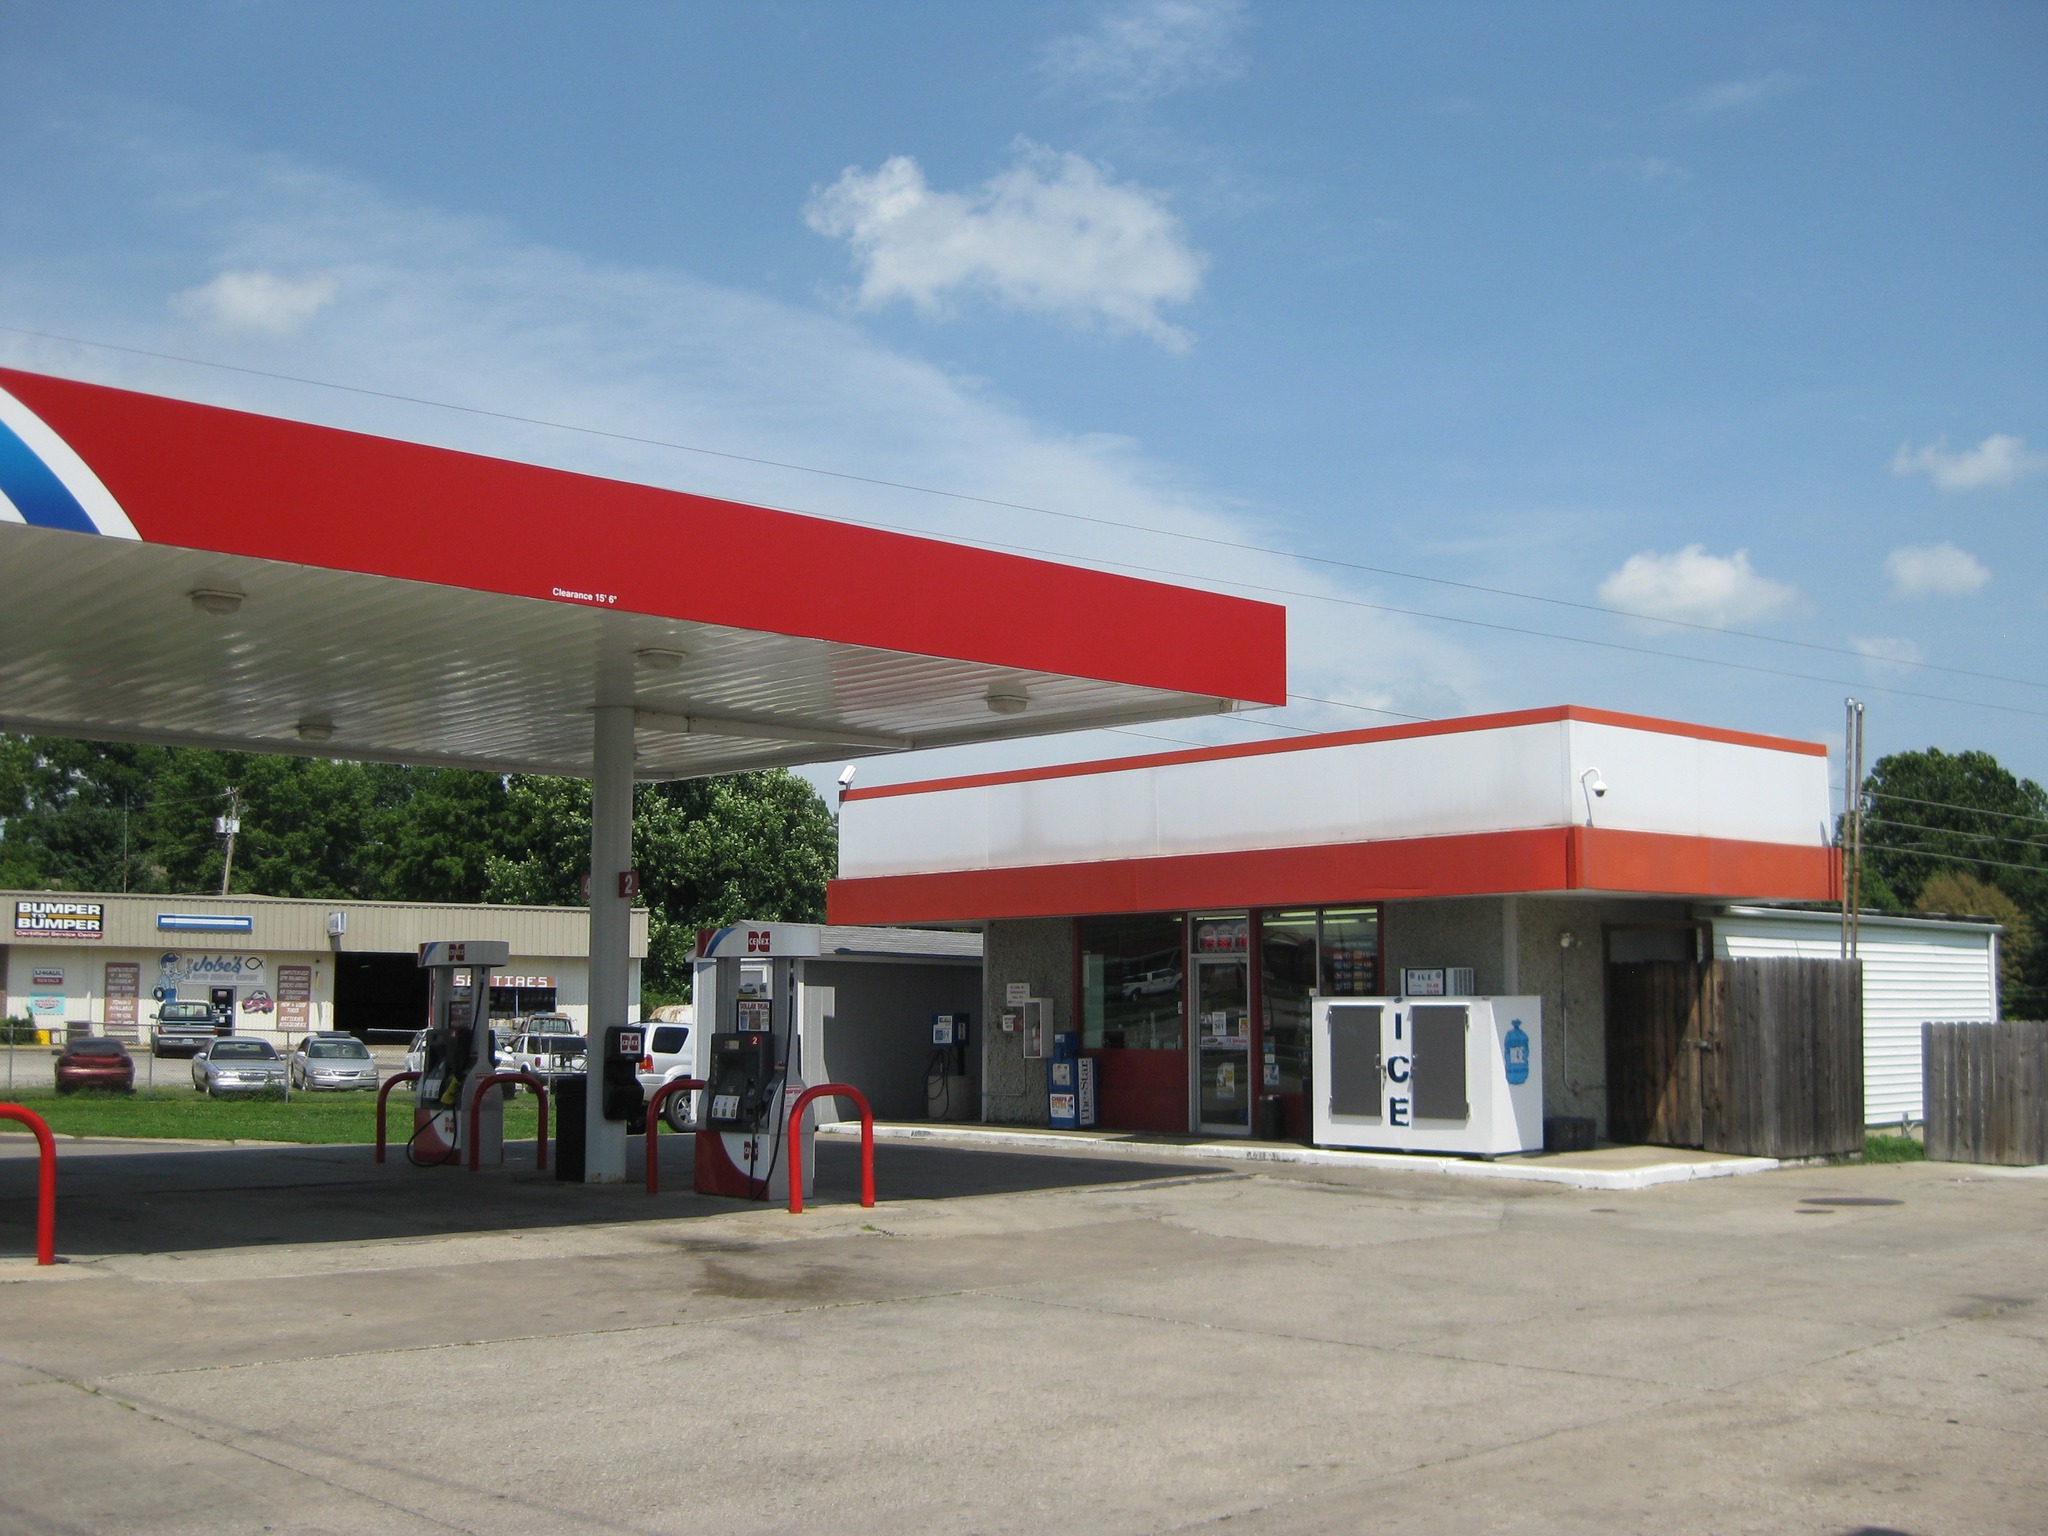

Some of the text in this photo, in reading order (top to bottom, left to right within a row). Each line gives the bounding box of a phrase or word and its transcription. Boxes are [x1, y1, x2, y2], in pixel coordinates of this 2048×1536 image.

[552, 587, 593, 601] Clearance
[595, 593, 607, 602] 15'
[625, 874, 633, 894] 2
[18, 902, 101, 915] BUMPER
[18, 917, 100, 931] BUMPER
[748, 937, 770, 946] CENEX
[192, 955, 242, 974] Jobe's
[493, 975, 548, 987] TIRES
[752, 1036, 758, 1045] 2
[1387, 1012, 1410, 1127] ICE
[1080, 1060, 1090, 1120] The Star
